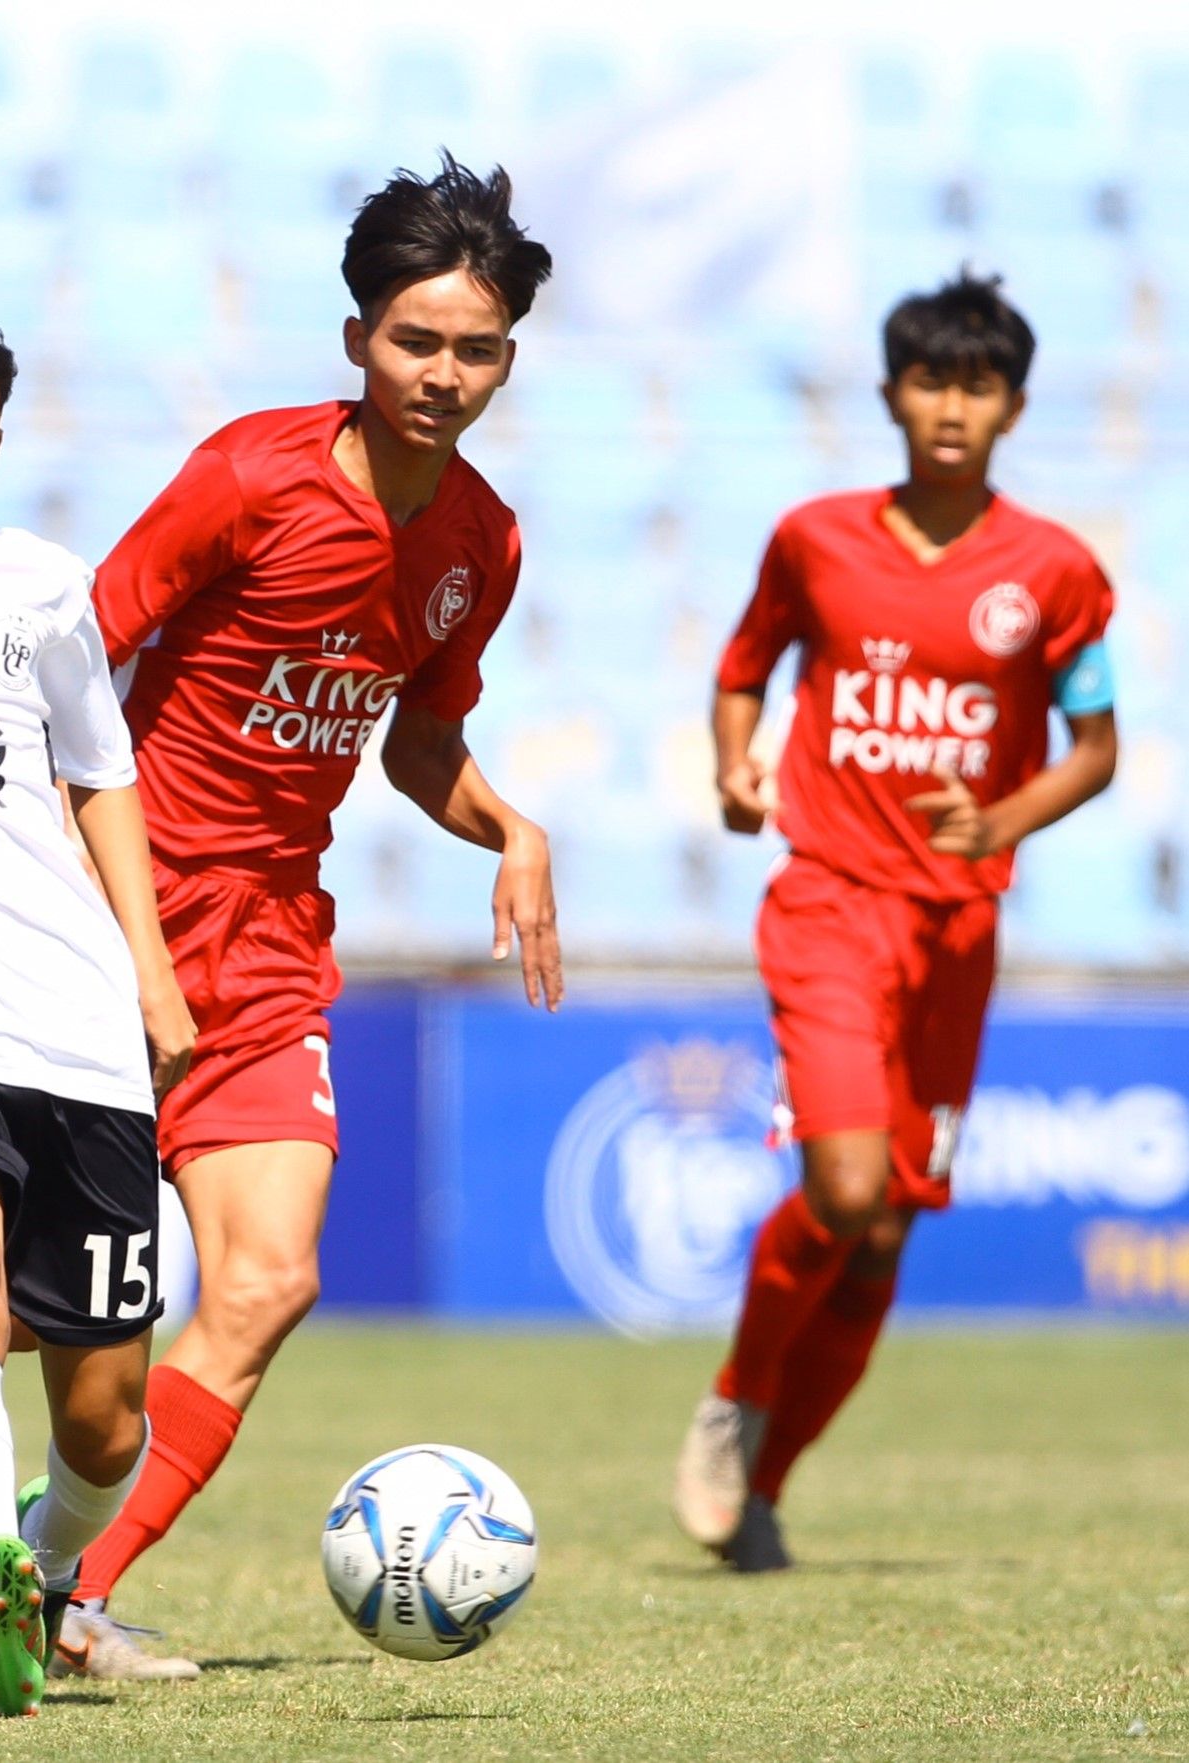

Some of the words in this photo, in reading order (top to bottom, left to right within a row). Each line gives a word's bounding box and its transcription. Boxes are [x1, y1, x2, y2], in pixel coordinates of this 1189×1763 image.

[260, 655, 407, 714] KING
[832, 669, 999, 737] KING
[828, 727, 991, 779] POWER
[83, 1229, 152, 1319] 15
[391, 1525, 416, 1626] molten
